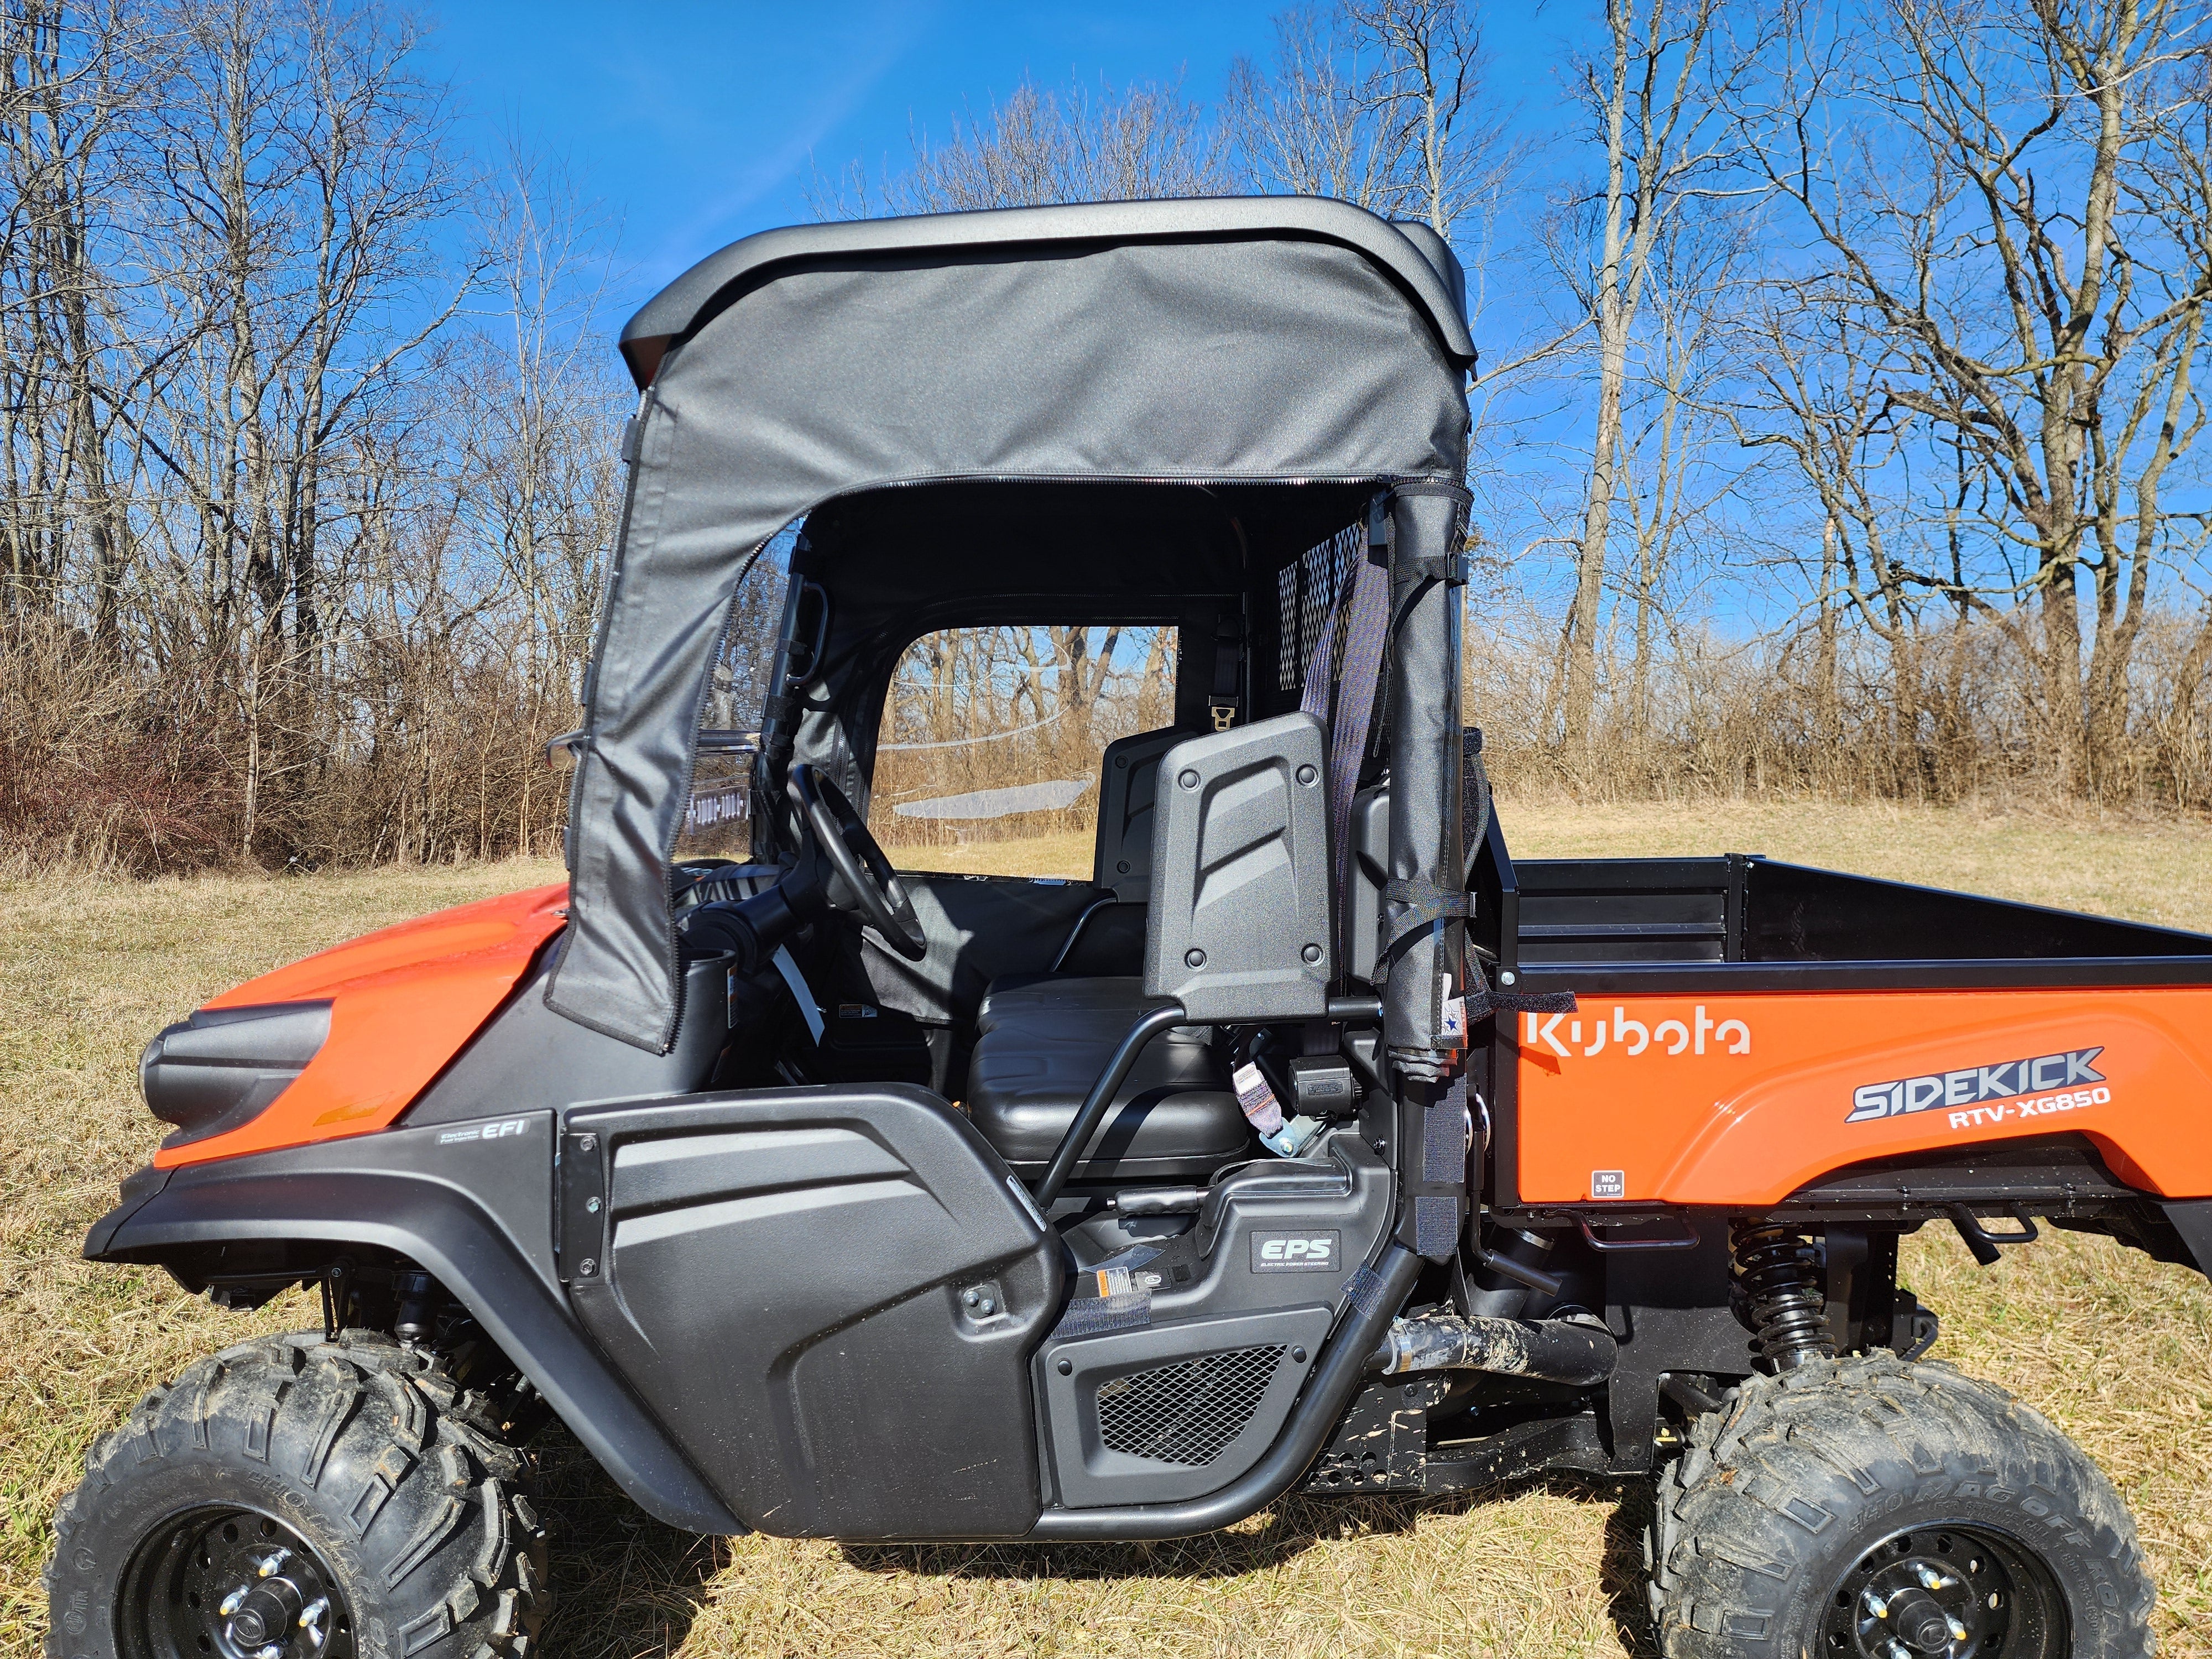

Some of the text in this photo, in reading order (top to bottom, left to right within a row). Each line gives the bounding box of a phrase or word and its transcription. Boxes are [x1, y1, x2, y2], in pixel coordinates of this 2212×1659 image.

[1527, 1005, 1750, 1057] Kubota
[1845, 1047, 2106, 1123] SIDEKICK
[1948, 1087, 2111, 1129] RTV-XG850
[482, 1120, 525, 1139] EFI
[1595, 1184, 1621, 1192] STEP
[1601, 1175, 1616, 1183] NO
[1261, 1239, 1332, 1259] EPS
[1912, 1480, 2017, 1504] MAG
[2020, 1496, 2093, 1548] OFF
